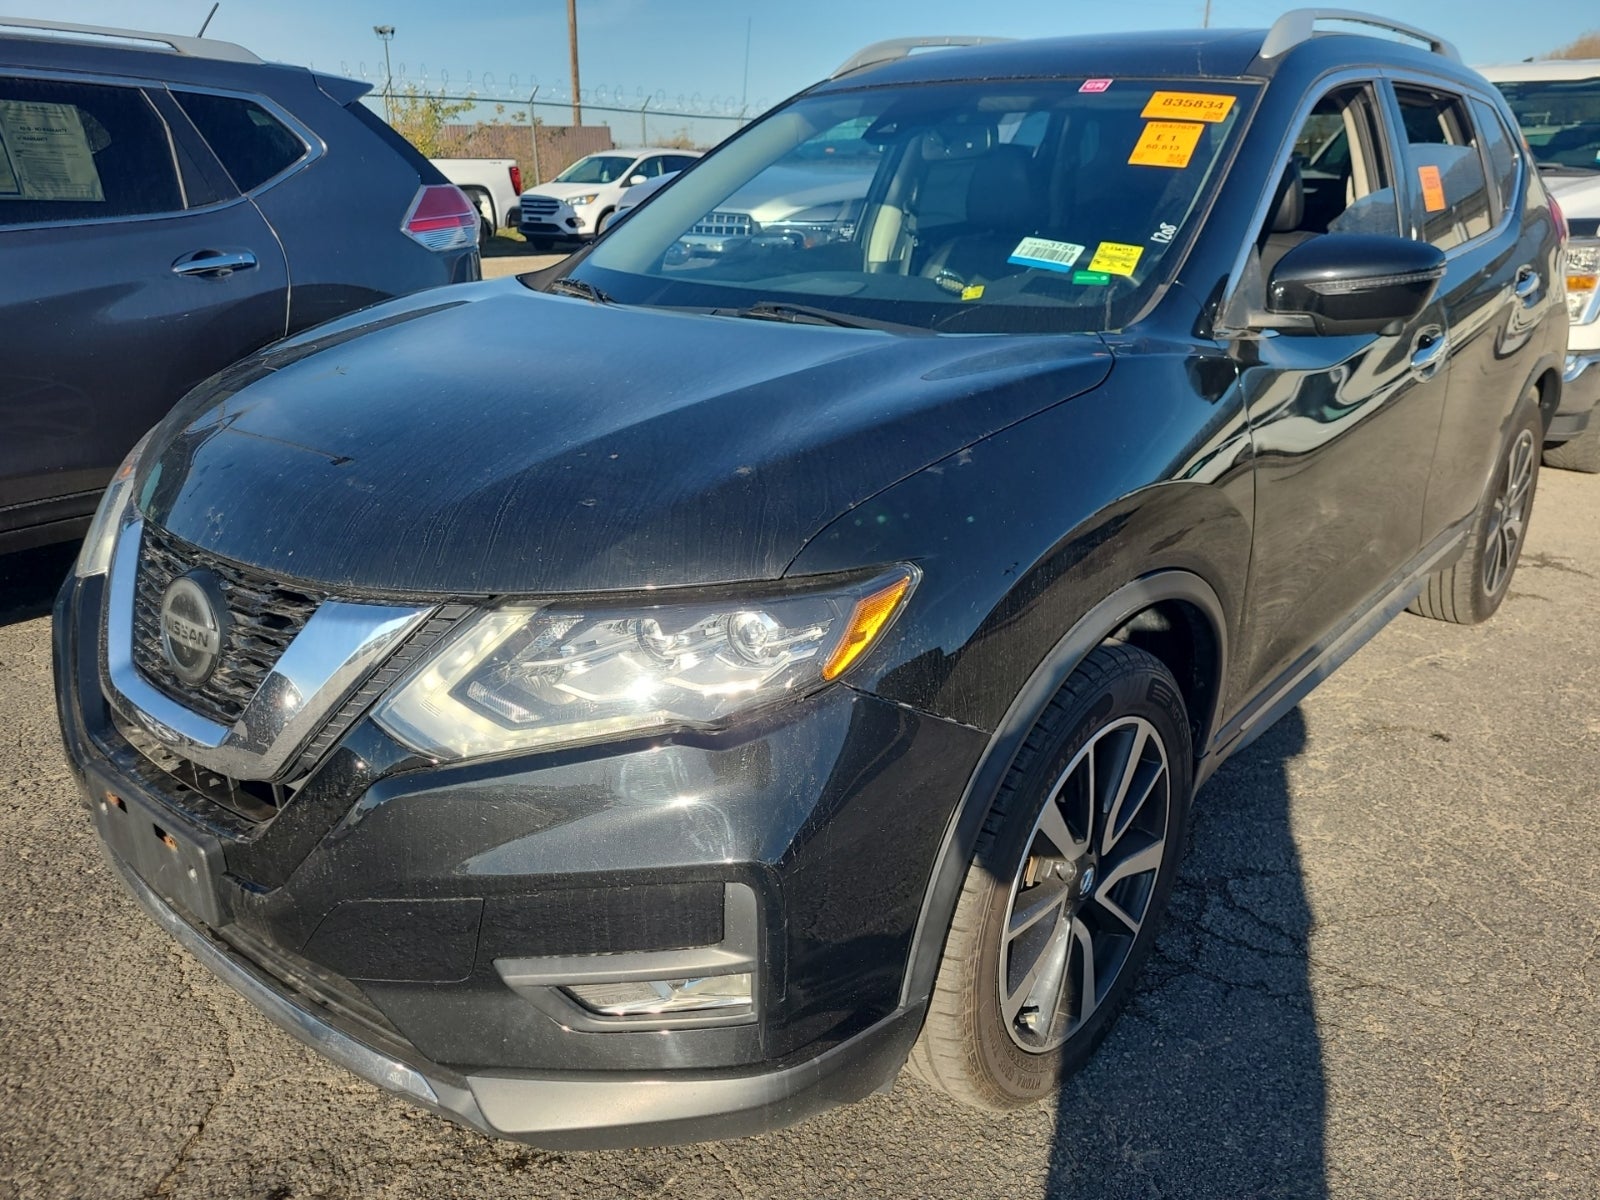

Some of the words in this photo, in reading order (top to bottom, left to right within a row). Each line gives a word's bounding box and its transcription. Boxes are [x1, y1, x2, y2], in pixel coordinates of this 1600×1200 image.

[1162, 97, 1225, 110] 835834
[1150, 222, 1177, 243] 1208
[165, 614, 209, 648] NISSAN
